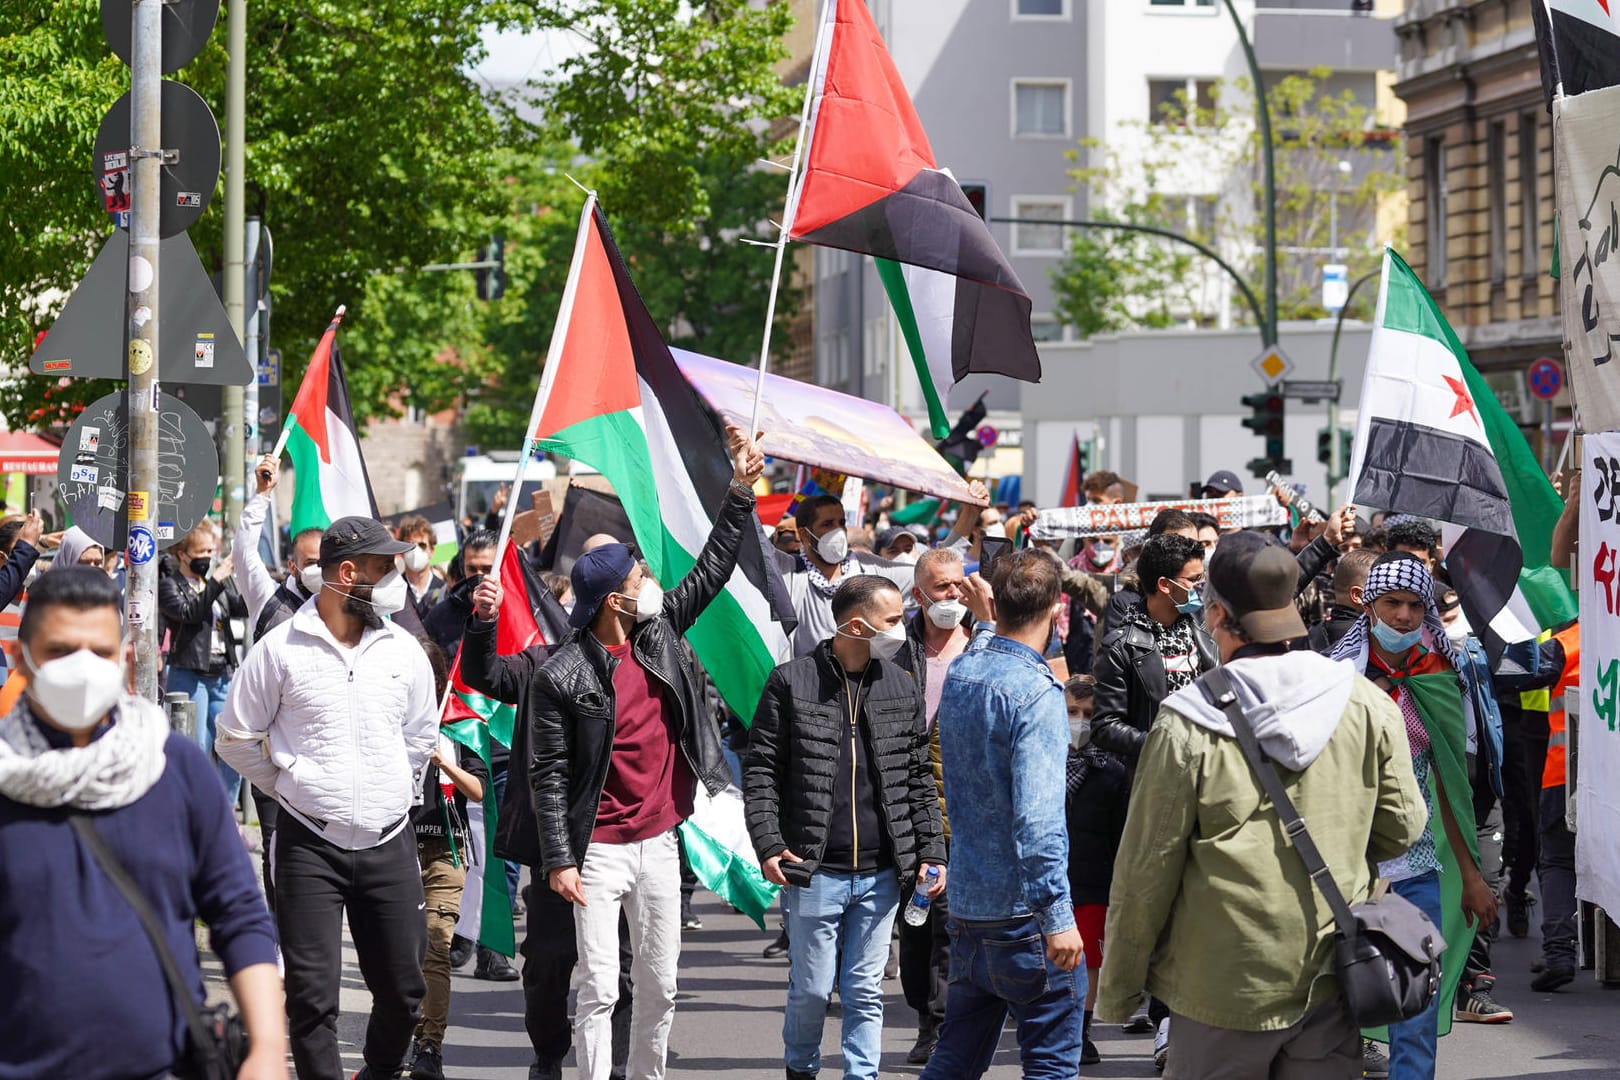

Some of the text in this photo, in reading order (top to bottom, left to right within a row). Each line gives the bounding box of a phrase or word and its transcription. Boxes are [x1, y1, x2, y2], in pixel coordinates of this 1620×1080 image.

[72, 468, 96, 482] BSG
[1089, 501, 1233, 532] PALENE
[415, 824, 442, 834] HAPPEN
